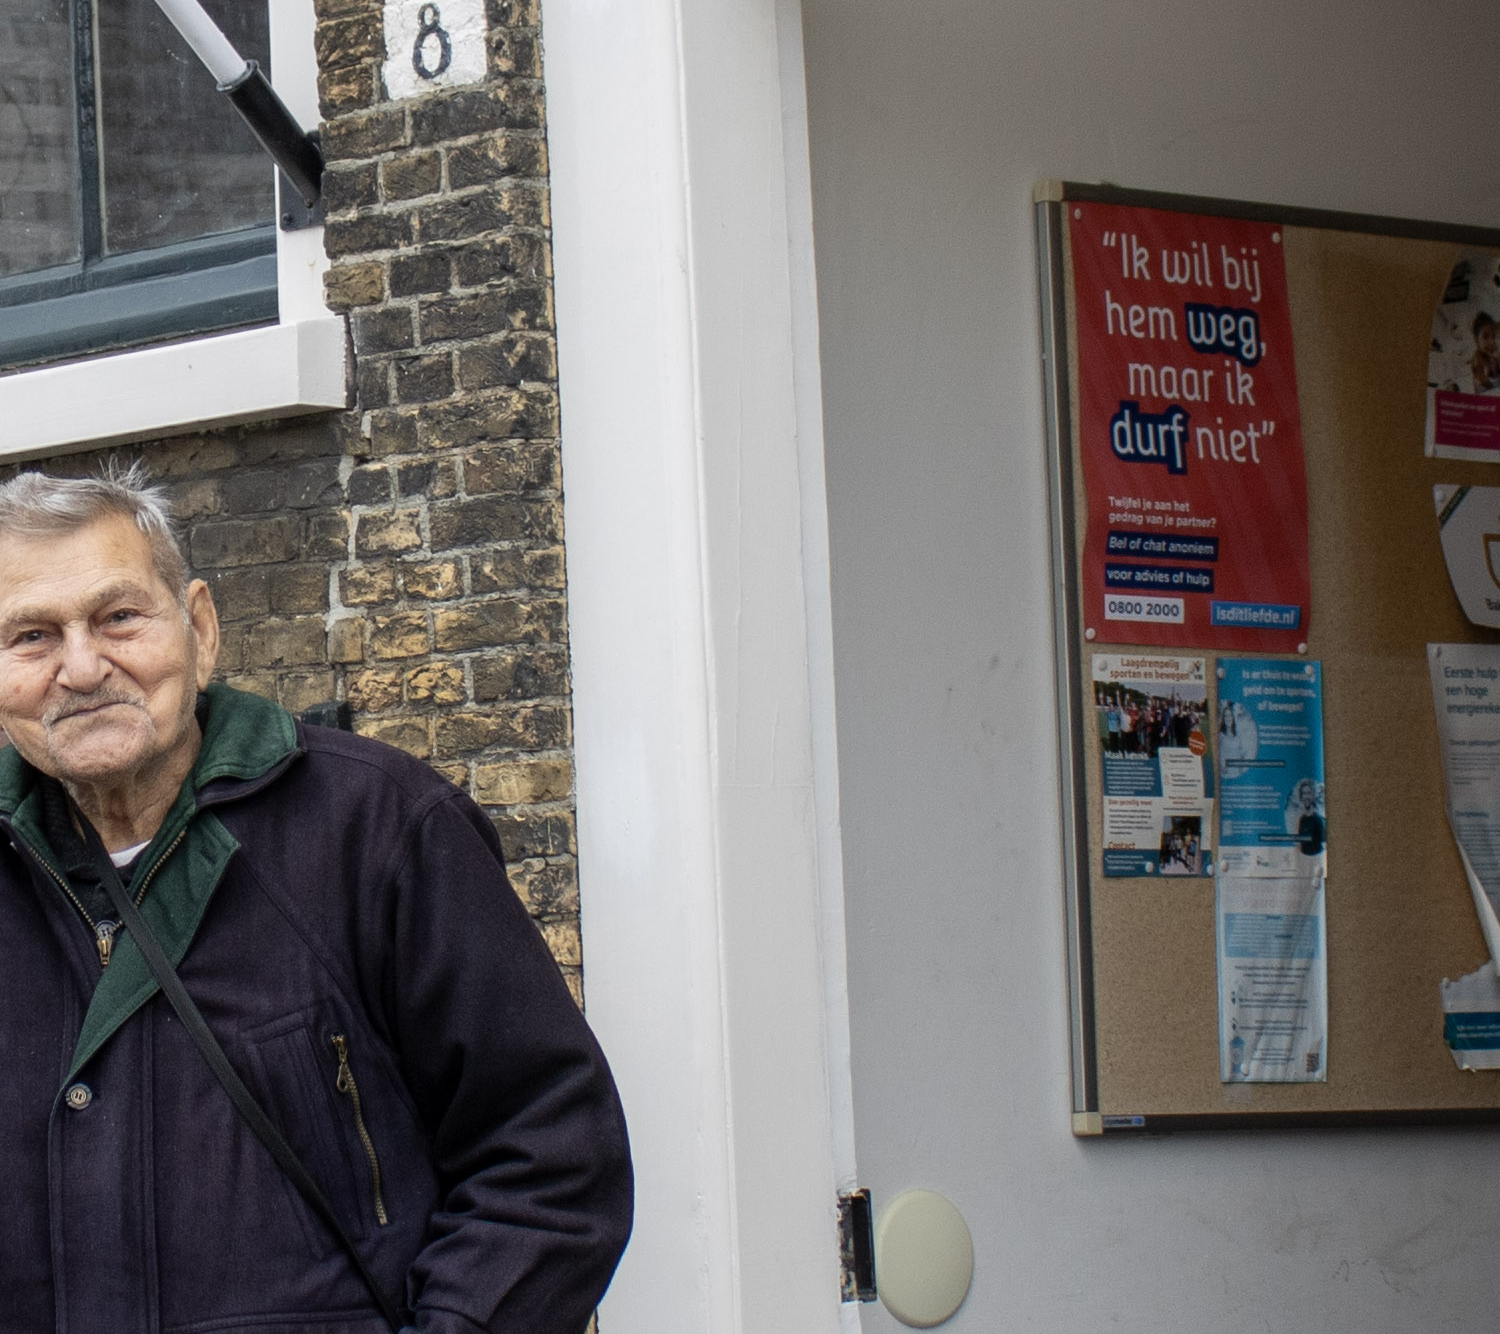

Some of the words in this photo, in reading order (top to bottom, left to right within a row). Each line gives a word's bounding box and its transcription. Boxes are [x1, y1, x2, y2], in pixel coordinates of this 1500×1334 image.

[412, 2, 453, 80] 8
[1162, 241, 1212, 288] wil
[1221, 245, 1262, 303] bij
[1105, 290, 1177, 341] hem
[1188, 307, 1266, 360] weg,
[1128, 361, 1214, 401] maar
[1225, 361, 1255, 406] ik
[1114, 410, 1185, 469] durf
[1109, 495, 1141, 513] Twijfel
[1142, 497, 1151, 513] je
[1154, 500, 1172, 512] aan
[1174, 500, 1189, 512] het
[1109, 512, 1142, 528] gedrag
[1146, 514, 1162, 525] van
[1163, 514, 1174, 528] je
[1176, 515, 1216, 529] partner?
[1109, 535, 1127, 549] Bel
[1129, 537, 1140, 551] of
[1142, 538, 1165, 552] chat
[1168, 541, 1214, 554] anoniem
[1107, 568, 1132, 580] voor
[1134, 567, 1169, 583] advies
[1172, 569, 1183, 584] of
[1185, 571, 1210, 588] hulp
[1109, 599, 1141, 616] 0800
[1146, 602, 1180, 618] 2000
[1215, 603, 1294, 625] isditliefde.nl
[1110, 668, 1141, 680] sporten
[1143, 669, 1154, 679] en
[1155, 669, 1190, 681] bewegen
[1465, 684, 1489, 700] hoge
